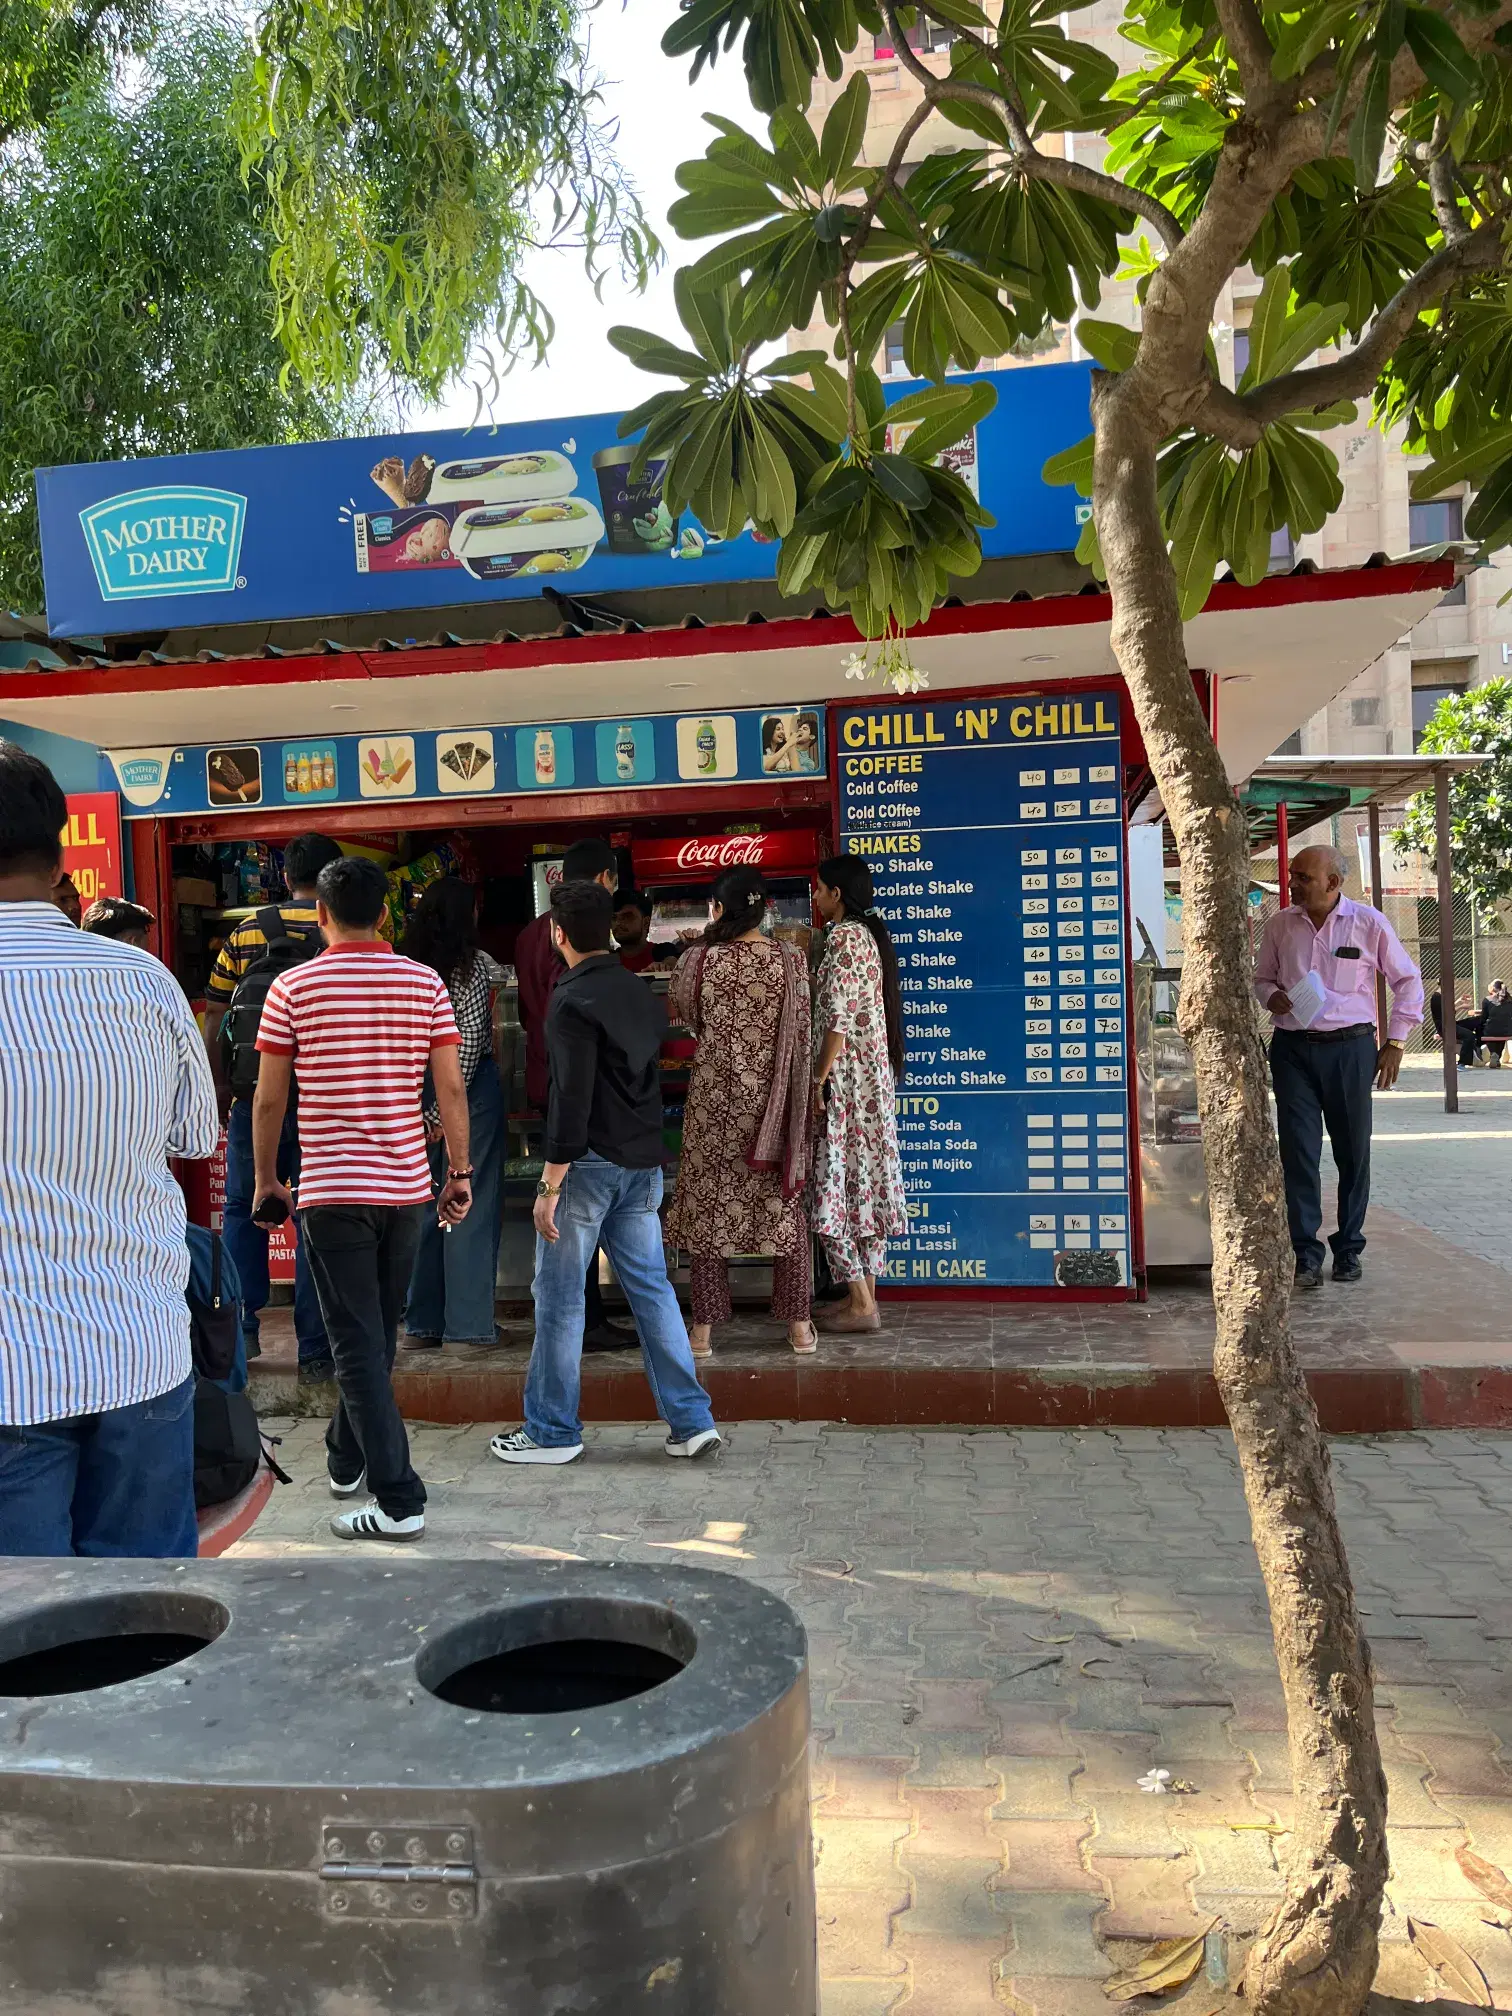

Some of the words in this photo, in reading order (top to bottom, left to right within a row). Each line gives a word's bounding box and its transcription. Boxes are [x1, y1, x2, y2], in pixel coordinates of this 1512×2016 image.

[101, 514, 228, 556] MOTHER
[357, 518, 366, 548] FREE
[126, 546, 209, 577] DAIRY
[843, 712, 945, 747] CHILL
[1010, 701, 1115, 738] CHILL
[124, 766, 159, 777] MOTHER
[846, 754, 923, 776] COFFEE
[131, 773, 154, 782] DAIRY
[1026, 773, 1041, 783] 40
[1060, 771, 1073, 780] 50
[1096, 768, 1109, 778] 60
[846, 781, 874, 796] Cold
[877, 779, 919, 795] Coffee
[847, 805, 875, 820] Cold
[878, 803, 921, 818] COffee
[1027, 806, 1041, 815] 40
[1094, 801, 1109, 811] 60
[848, 834, 921, 855] SHAKES
[677, 835, 768, 869] Coca-Cola
[1023, 853, 1039, 862] 50
[1062, 849, 1075, 860] 60
[1093, 850, 1108, 859] 70
[888, 857, 934, 873] Shake
[928, 879, 974, 895] Shake
[1025, 877, 1041, 887] 40
[1061, 874, 1076, 885] 50
[1095, 874, 1110, 882] 60
[1027, 901, 1046, 911] 50
[1062, 899, 1078, 909] 60
[1098, 898, 1115, 908] 70
[875, 906, 902, 920] Kat
[906, 904, 952, 920] Shake
[917, 928, 963, 942] Shake
[1030, 925, 1048, 935] 50
[1064, 922, 1081, 934] 60
[1097, 922, 1117, 932] 70
[910, 952, 956, 967] Shake
[927, 976, 973, 990] Shake
[1032, 973, 1047, 983] 40
[1067, 973, 1082, 983] 50
[1101, 970, 1117, 980] 60
[902, 1000, 948, 1015] Shake
[905, 1024, 951, 1039] Shake
[1026, 1021, 1047, 1032] 50
[1065, 1020, 1082, 1031] 60
[1096, 1019, 1119, 1033] 70
[902, 1051, 936, 1065] erry
[940, 1047, 987, 1061] Shake
[1031, 1046, 1049, 1057] 50
[1065, 1045, 1081, 1055] 60
[904, 1071, 956, 1086] Scotch
[960, 1071, 1007, 1085] Shake
[1031, 1070, 1048, 1081] 50
[1065, 1069, 1083, 1080] 60
[1102, 1068, 1119, 1079] 70
[929, 1119, 962, 1131] Soda
[897, 1139, 941, 1150] Masala
[945, 1138, 977, 1150] Soda
[932, 1158, 973, 1172] Mojito
[910, 1221, 951, 1234] Lassi
[915, 1238, 957, 1251] Lassi
[268, 1248, 297, 1260] PASTA
[880, 1259, 907, 1278] KE
[912, 1259, 931, 1278] HI
[936, 1259, 987, 1278] CAKE
